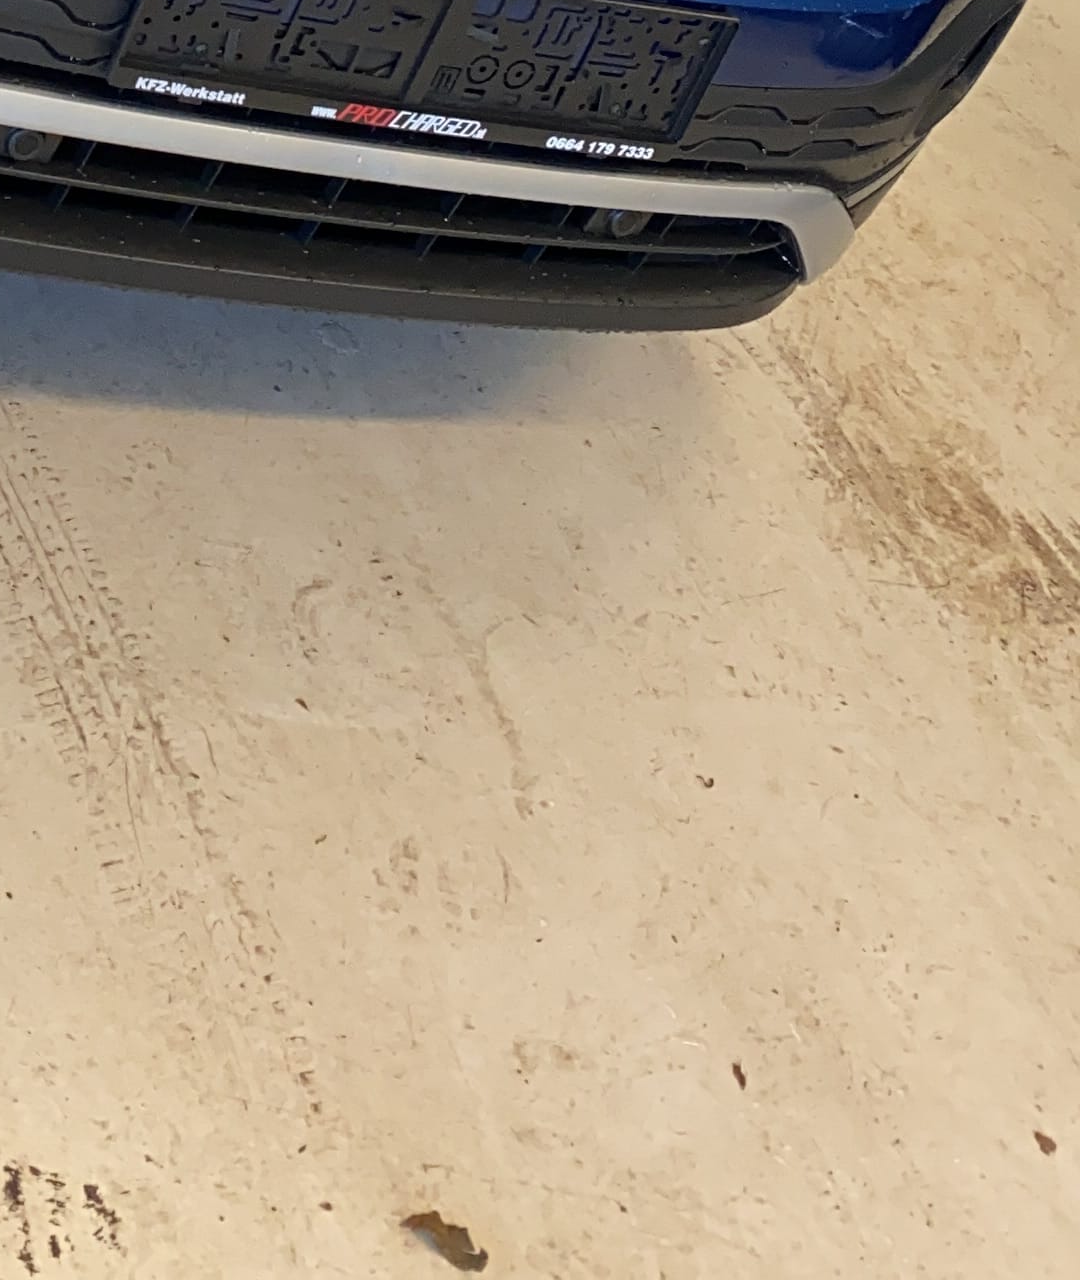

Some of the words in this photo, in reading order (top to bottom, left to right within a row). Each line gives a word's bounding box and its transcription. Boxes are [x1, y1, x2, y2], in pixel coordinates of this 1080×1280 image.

[135, 76, 246, 105] KFZ-Werkstatt
[545, 135, 585, 152] 0664
[587, 141, 616, 155] 179
[617, 144, 654, 160] 7333
